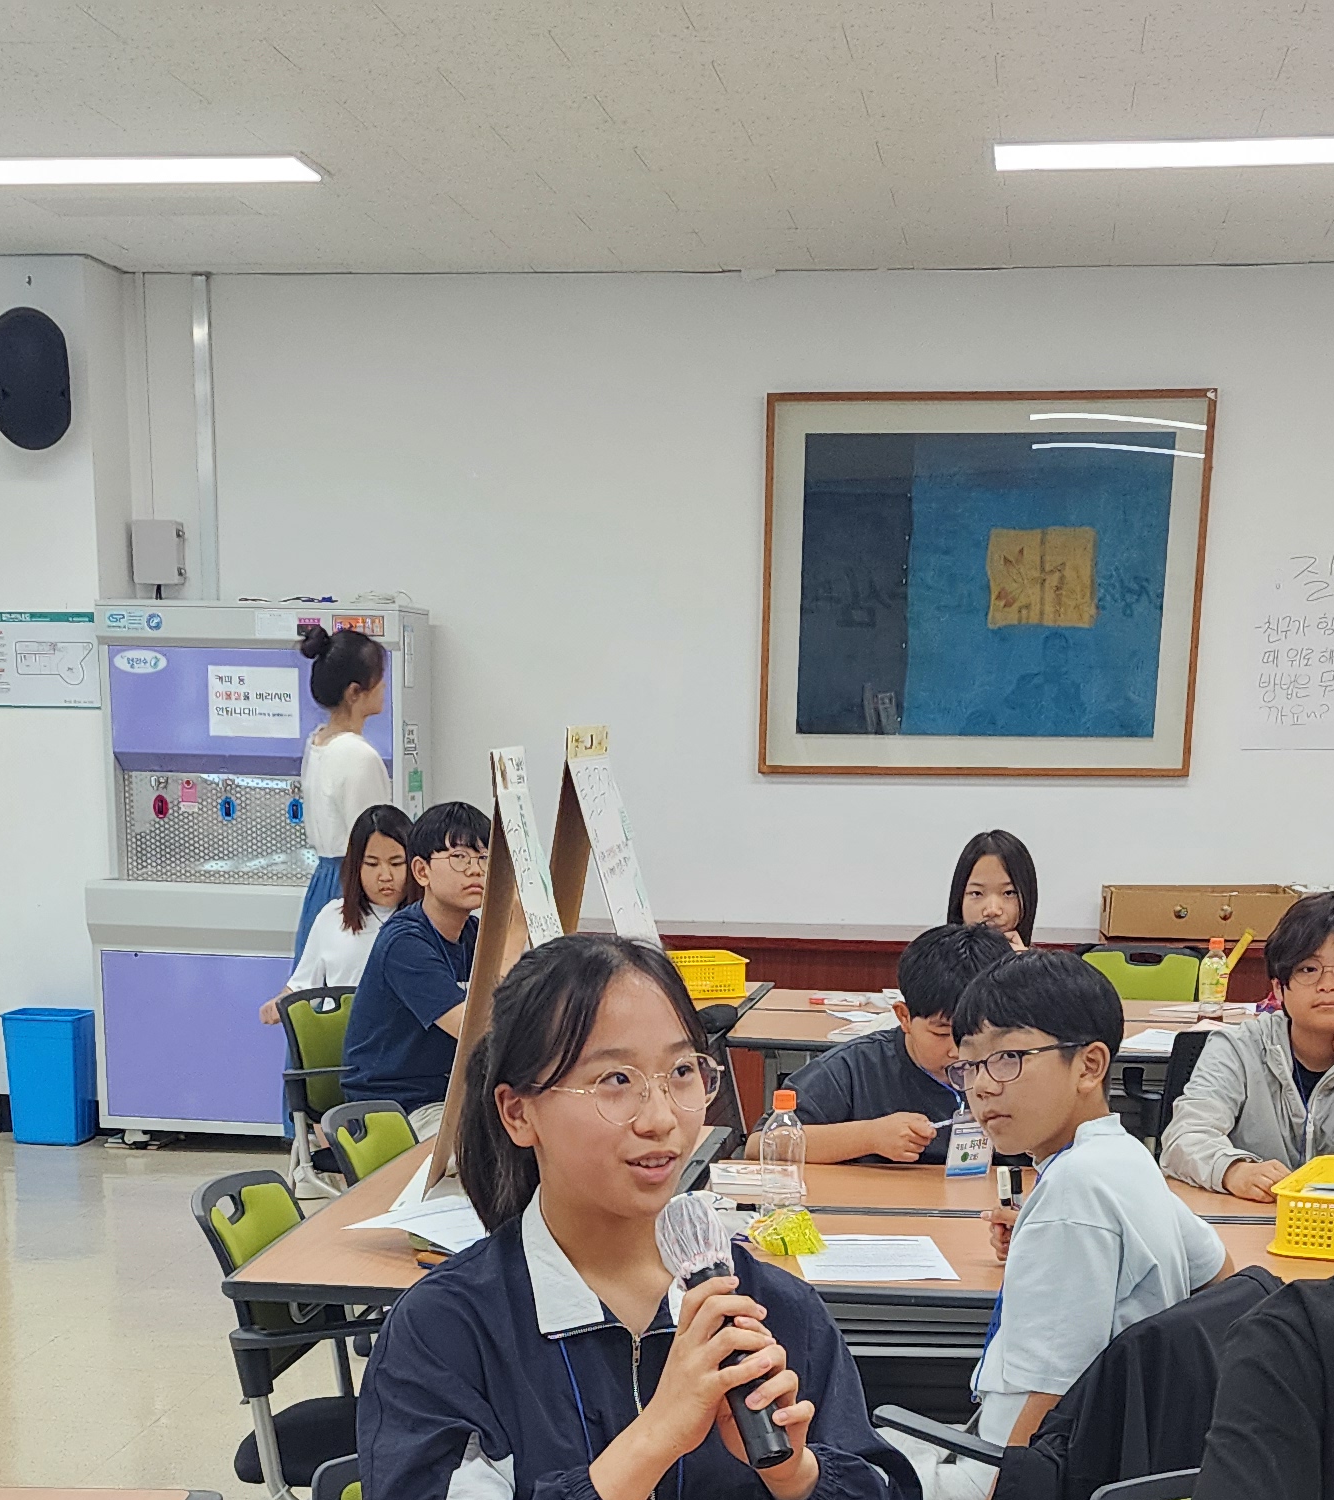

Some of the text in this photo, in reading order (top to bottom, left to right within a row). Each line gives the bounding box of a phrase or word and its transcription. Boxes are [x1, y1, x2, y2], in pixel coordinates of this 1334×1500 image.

[1261, 648, 1280, 668] 때
[1286, 647, 1314, 668] 위로
[214, 674, 233, 686] 커피
[1258, 672, 1311, 704] 방법은
[214, 690, 251, 702] 이물질을
